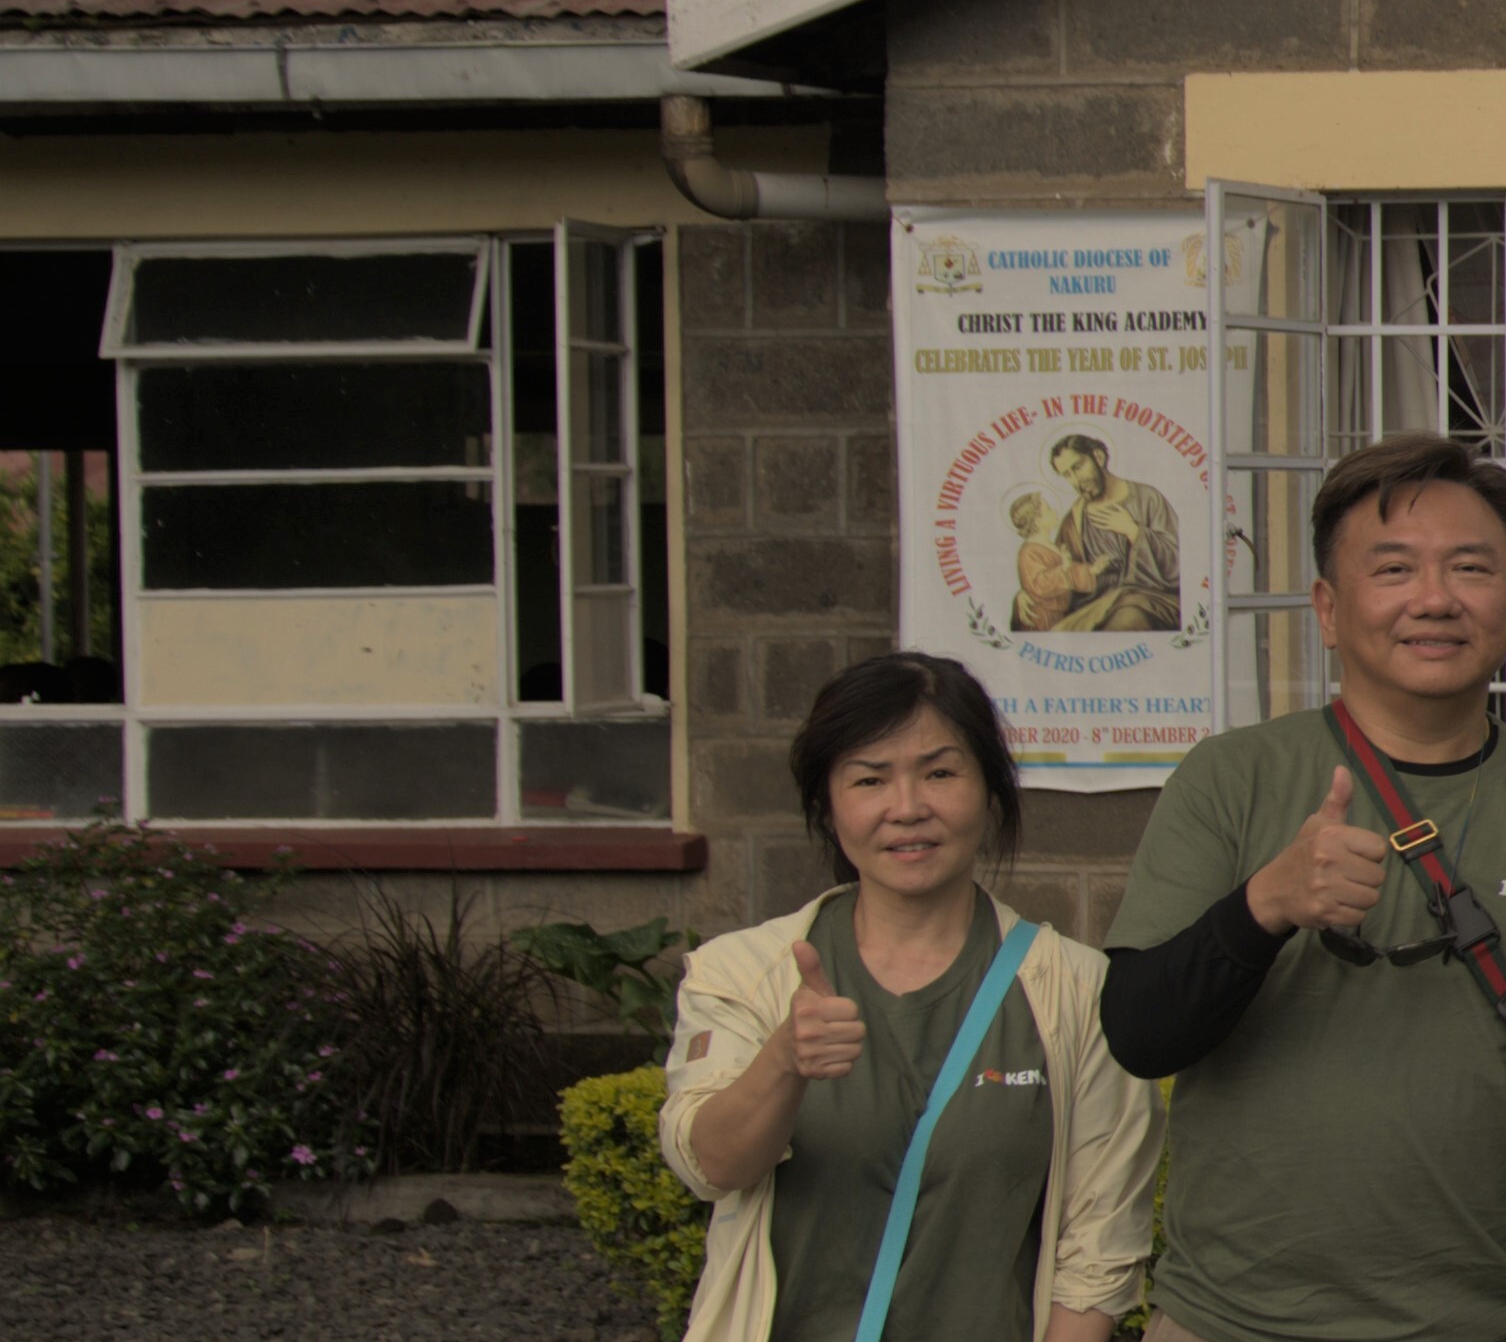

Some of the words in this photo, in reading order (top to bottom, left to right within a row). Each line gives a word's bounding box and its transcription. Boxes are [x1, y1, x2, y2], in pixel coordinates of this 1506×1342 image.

[988, 249, 1068, 269] CATHOLIC
[1073, 249, 1144, 268] DIOCESE
[1148, 248, 1171, 267] OF
[1049, 275, 1116, 295] NAKURU
[958, 313, 1023, 333] CHRIST
[1029, 313, 1066, 333] THE
[1072, 312, 1118, 332] KING
[1124, 311, 1207, 332] ACADEMY
[914, 348, 1021, 374] CELEBRATES
[1026, 348, 1062, 373] THE
[1067, 347, 1115, 372] YEAR
[1120, 347, 1141, 372] OF
[1147, 346, 1173, 371] ST.
[1178, 345, 1248, 374] JOSPH
[1041, 396, 1064, 419] IN
[1070, 394, 1109, 415] THE
[1113, 398, 1208, 468] FOOTSTEPS
[936, 431, 996, 510] VIRTUOUS
[934, 519, 956, 530] A
[935, 536, 972, 597] LIVING
[1018, 641, 1085, 674] PATRIS
[1088, 642, 1153, 674] CORDE
[1024, 697, 1038, 714] A
[1044, 696, 1139, 714] FATHER'S
[1042, 727, 1080, 744] 2020
[1112, 726, 1197, 744] DECEMBER
